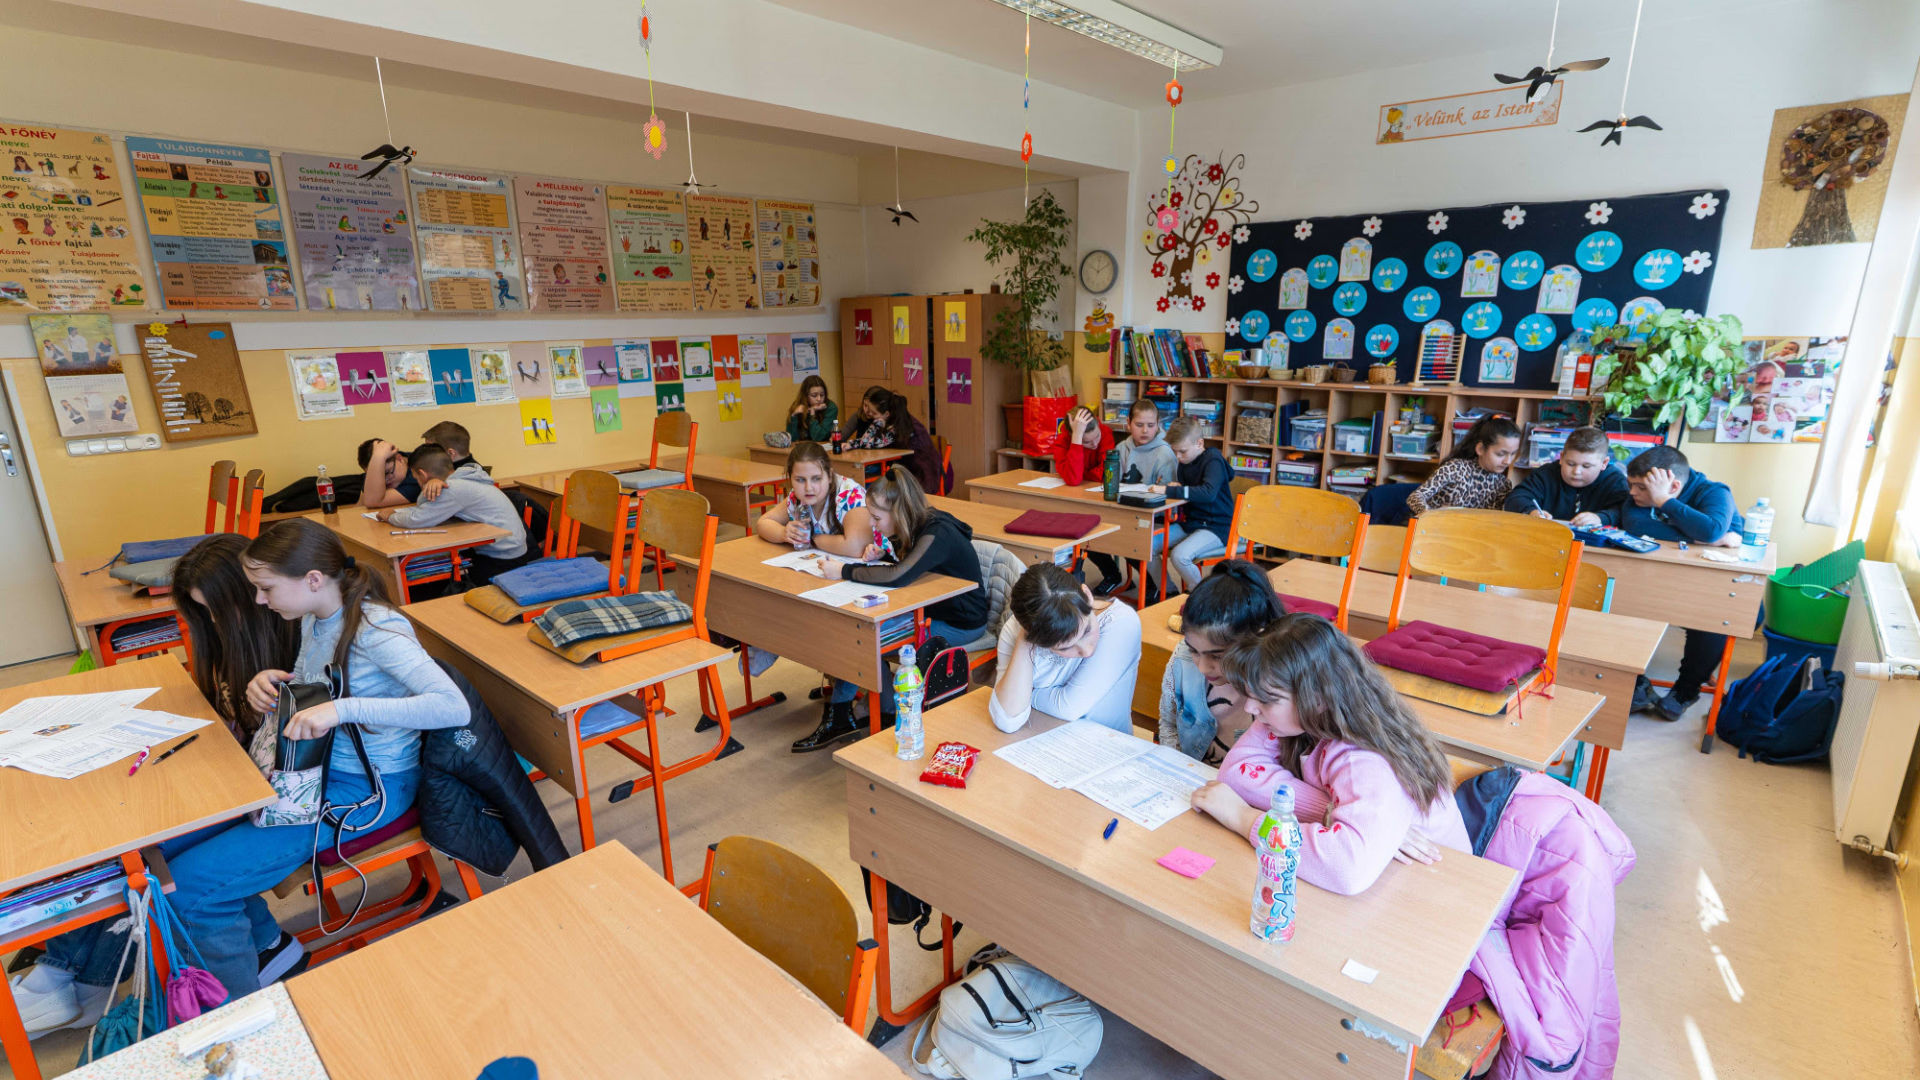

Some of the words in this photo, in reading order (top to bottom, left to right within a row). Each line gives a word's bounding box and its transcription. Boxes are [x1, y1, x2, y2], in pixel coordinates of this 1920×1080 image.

[1472, 109, 1490, 121] az
[10, 127, 57, 141] FŐNÉV
[156, 142, 245, 158] TULAJDONNEVEK
[136, 151, 161, 160] Fajták
[206, 158, 233, 167] Példák
[328, 162, 341, 170] AZ
[19, 202, 53, 212] dolgok
[30, 238, 61, 246] főnév
